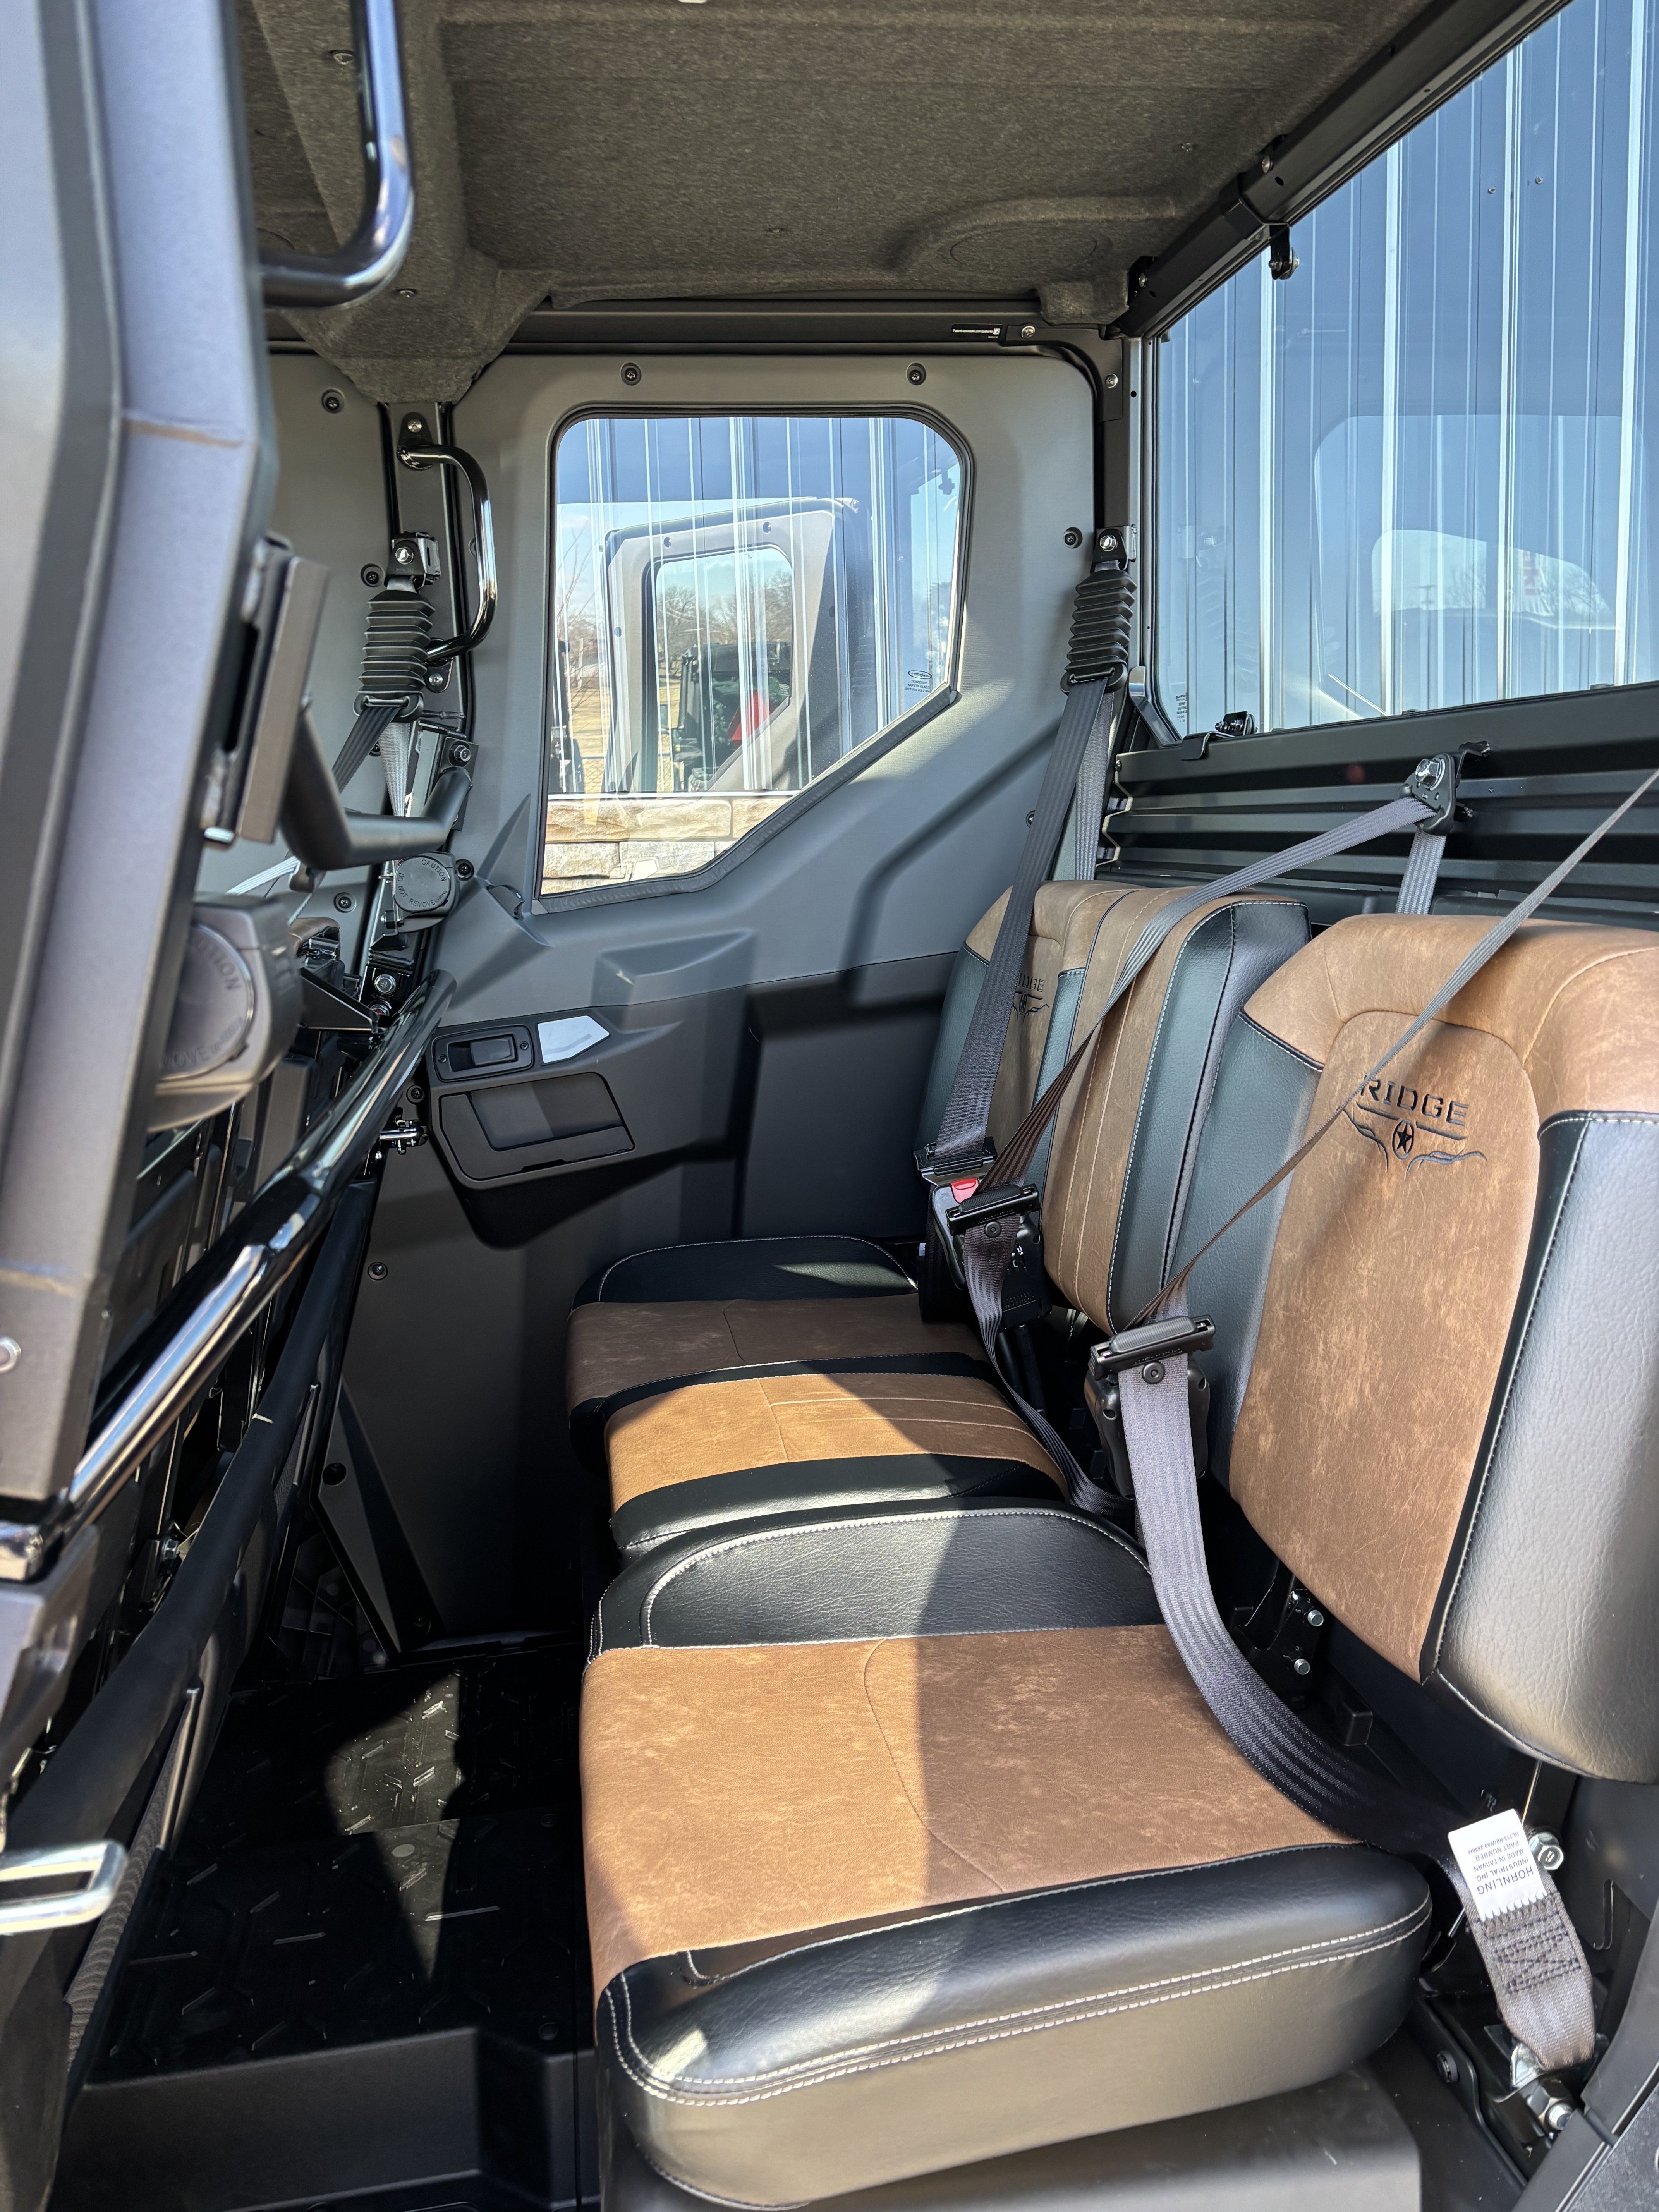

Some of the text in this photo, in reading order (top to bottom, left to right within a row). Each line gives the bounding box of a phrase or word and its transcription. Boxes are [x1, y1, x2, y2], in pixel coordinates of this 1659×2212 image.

[422, 859, 447, 881] CAUTION
[397, 872, 435, 908] DO NOT REMOVE
[1017, 973, 1045, 992] IDGE
[1360, 1075, 1468, 1126] RIDGE
[1475, 1840, 1519, 1862] PART NUMBER
[1507, 1848, 1524, 1860] MADE
[1474, 1859, 1498, 1872] TAIWAN
[1474, 1857, 1529, 1882] INDUSTRIAL INC.
[1477, 1866, 1534, 1895] HORNLING
